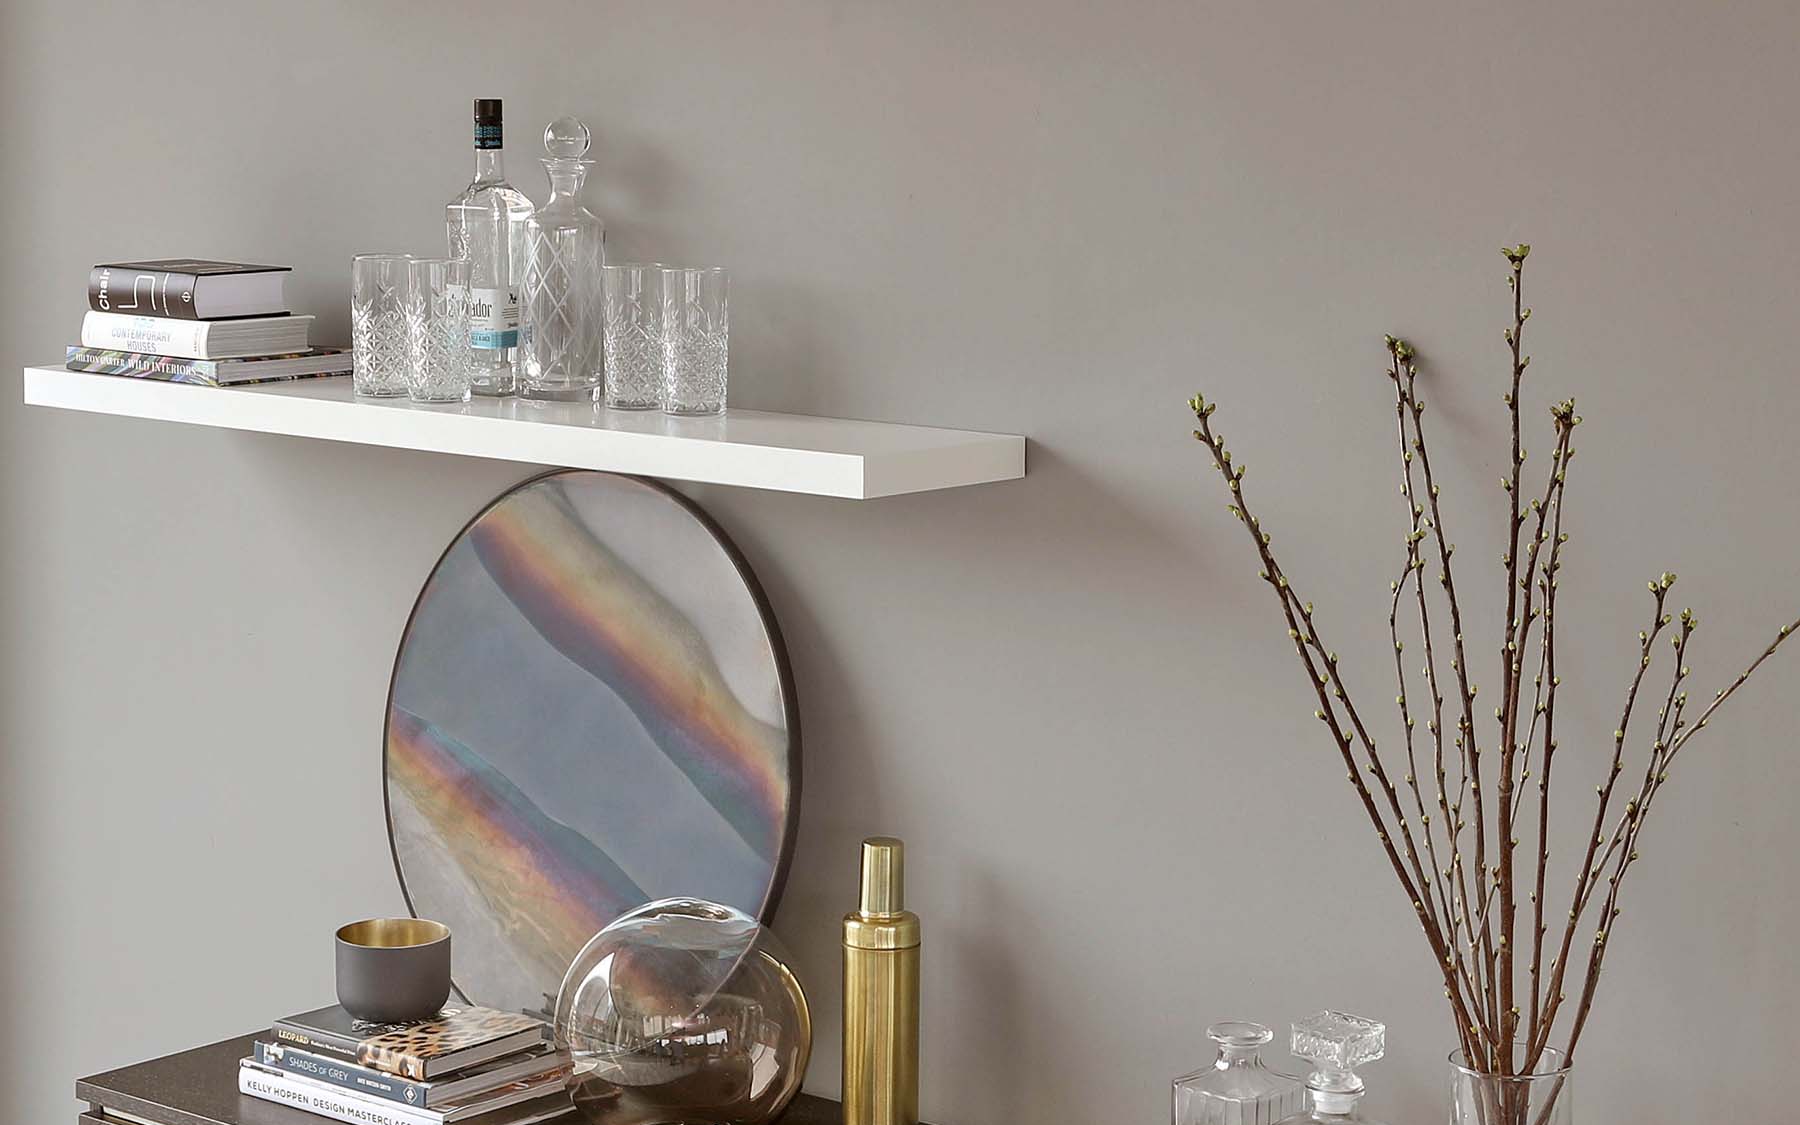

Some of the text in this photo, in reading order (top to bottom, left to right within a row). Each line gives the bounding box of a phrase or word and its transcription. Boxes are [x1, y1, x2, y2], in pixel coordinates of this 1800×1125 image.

[98, 268, 110, 310] Chair
[111, 327, 171, 343] CONTEMPORARY
[126, 340, 157, 353] HOUSES
[128, 358, 150, 371] WILD
[151, 361, 197, 376] INTERIORS
[278, 1029, 309, 1045] LEOPARD
[289, 1056, 318, 1073] SHADES
[328, 1068, 349, 1081] GREY
[247, 1080, 272, 1094] KELLY
[274, 1087, 309, 1104] HOPPEN
[313, 1097, 345, 1115] DESIGN
